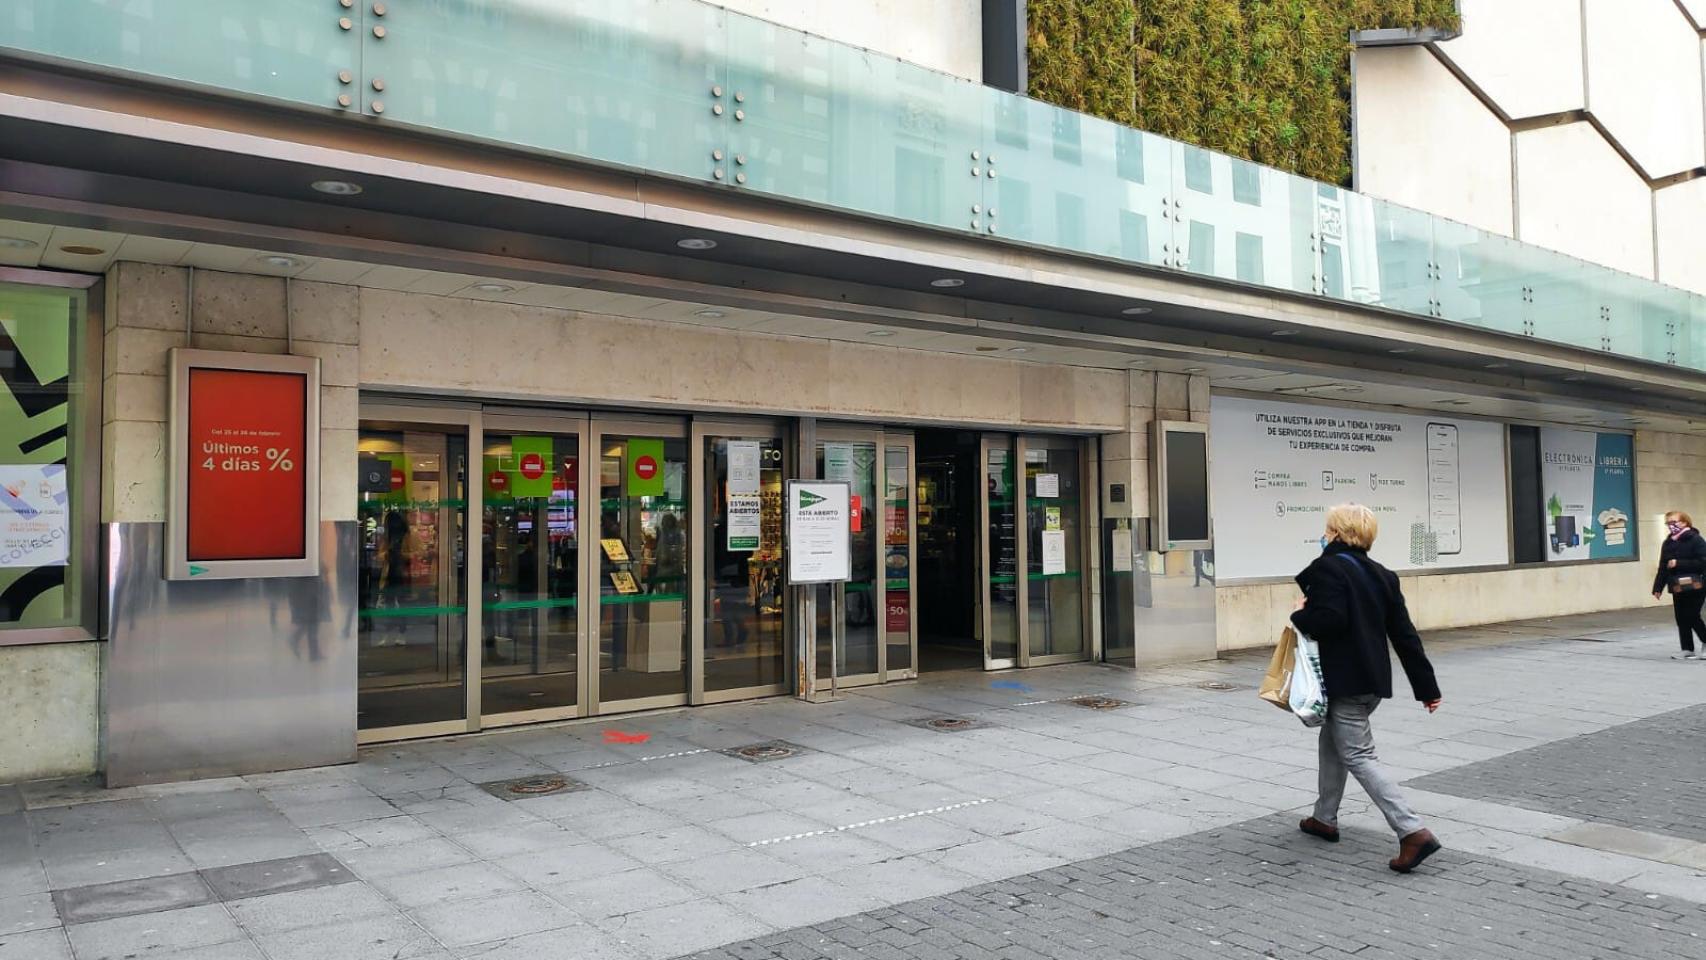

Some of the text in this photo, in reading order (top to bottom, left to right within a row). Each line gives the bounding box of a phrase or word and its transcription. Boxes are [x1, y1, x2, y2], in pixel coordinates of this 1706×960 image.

[1255, 413, 1401, 432] UTILIZA NUESTRA APP EN LA TIENDA Y DISFRUTA
[1267, 426, 1393, 442] DE SERVICIOS EXCLUSIVOS QUE MEJORAN
[203, 440, 259, 454] Últimos
[1289, 440, 1376, 452] TU EXPERIENCIA DE COMPRA
[202, 457, 260, 471] 4 días
